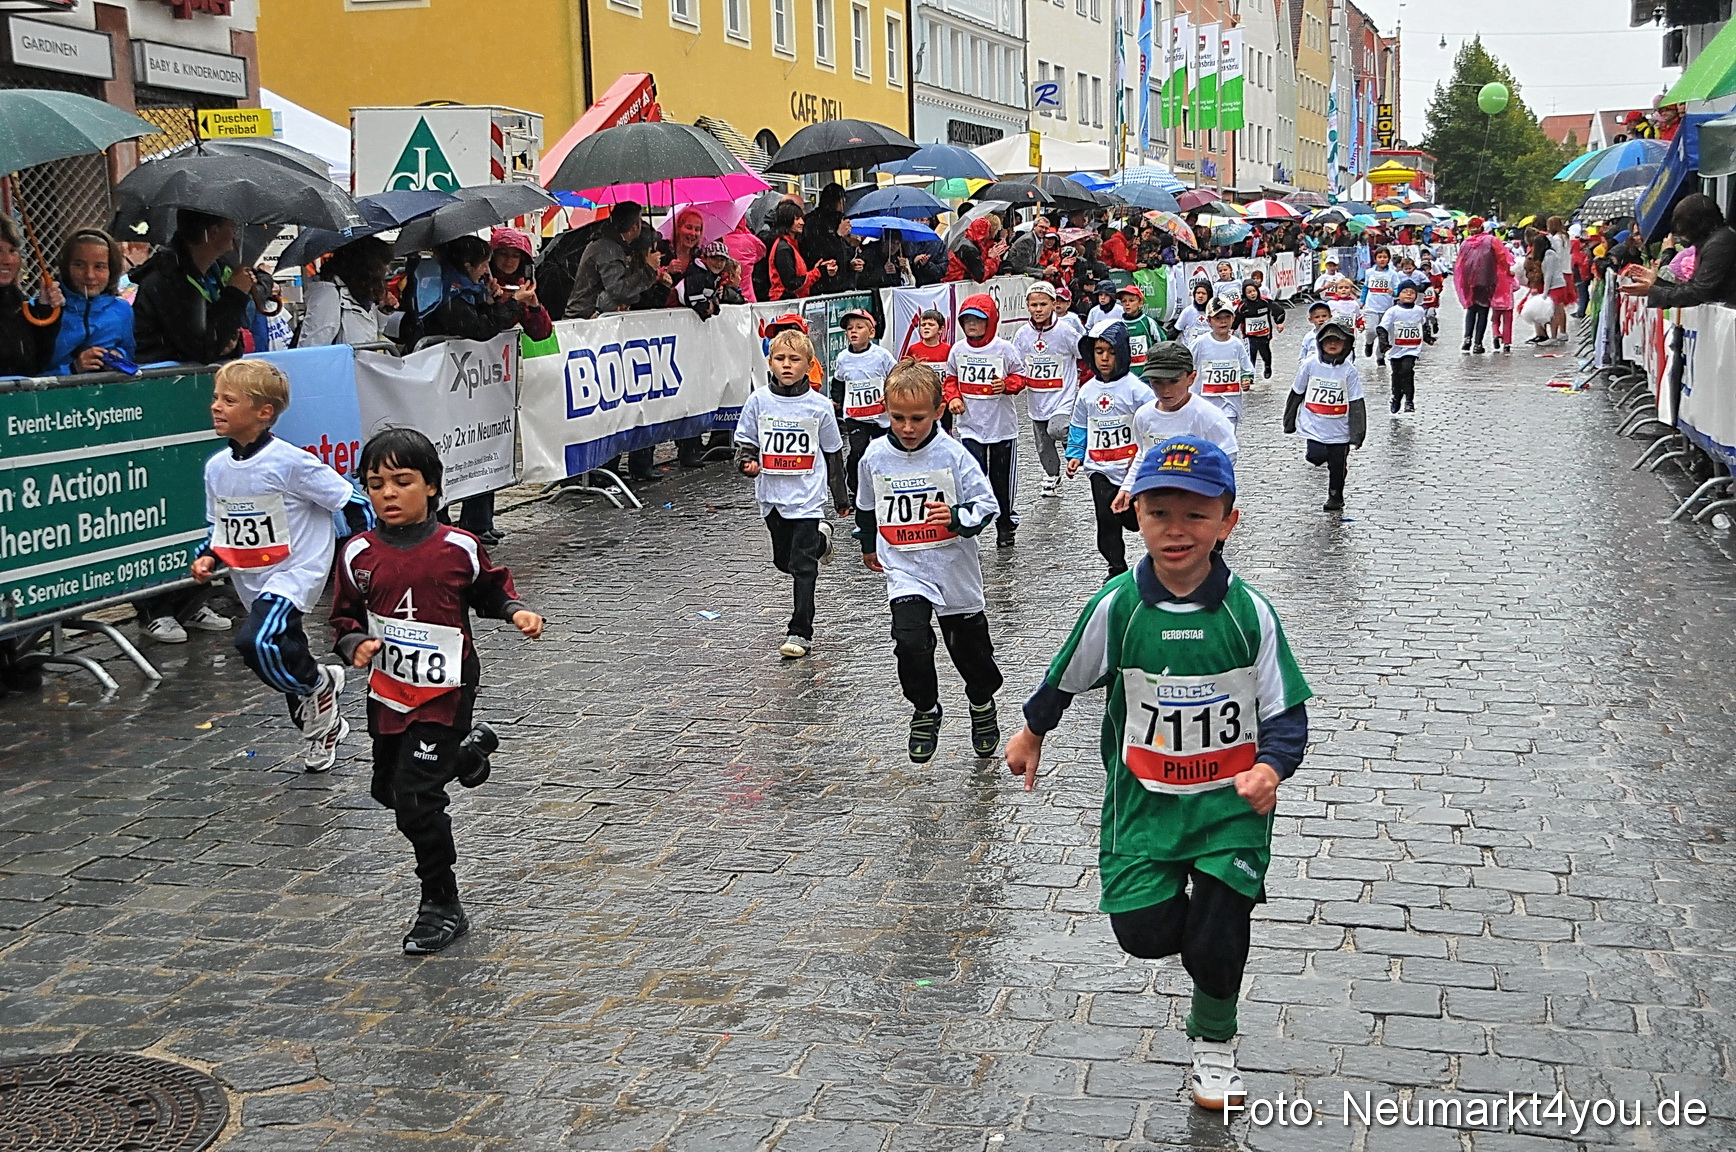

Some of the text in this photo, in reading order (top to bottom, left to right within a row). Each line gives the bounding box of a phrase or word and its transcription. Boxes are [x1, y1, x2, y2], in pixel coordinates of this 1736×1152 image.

[22, 36, 78, 57] GARDINEN
[150, 58, 242, 83] BABY & KINDERMODEN
[791, 91, 818, 124] CAFE
[214, 113, 259, 125] Duschen
[218, 124, 257, 135] Freibad
[1370, 280, 1389, 288] 7288
[1397, 328, 1420, 338] 7063
[450, 344, 511, 399] Xplus1
[564, 335, 683, 420] BOCK
[960, 365, 996, 383] 7344
[1028, 364, 1059, 379] 7257
[1205, 369, 1237, 384] 7350
[849, 388, 881, 406] 7160
[1311, 387, 1345, 405] 7254
[8, 405, 143, 437] Event-Leit-Systeme
[455, 427, 467, 448] 2x
[467, 424, 476, 444] in
[477, 414, 512, 442] Neumarkt
[1093, 426, 1132, 449] 7319
[763, 431, 810, 454] 7029
[773, 457, 797, 468] Marc
[22, 477, 41, 509] &
[48, 467, 122, 505] Action
[128, 460, 148, 491] in
[892, 477, 926, 489] BOCK
[79, 498, 167, 544] Bahnen!
[221, 515, 276, 546] 7231
[896, 527, 938, 542] Maxim
[12, 549, 188, 608] & Service Line: 09181 6352
[393, 586, 419, 621] 4
[384, 625, 429, 641] BOCK
[1161, 629, 1204, 641] DERBYSTAR
[1157, 682, 1216, 699] BOCK
[1140, 701, 1241, 752] 7113
[413, 751, 438, 761] erima
[1163, 759, 1219, 781] Philip
